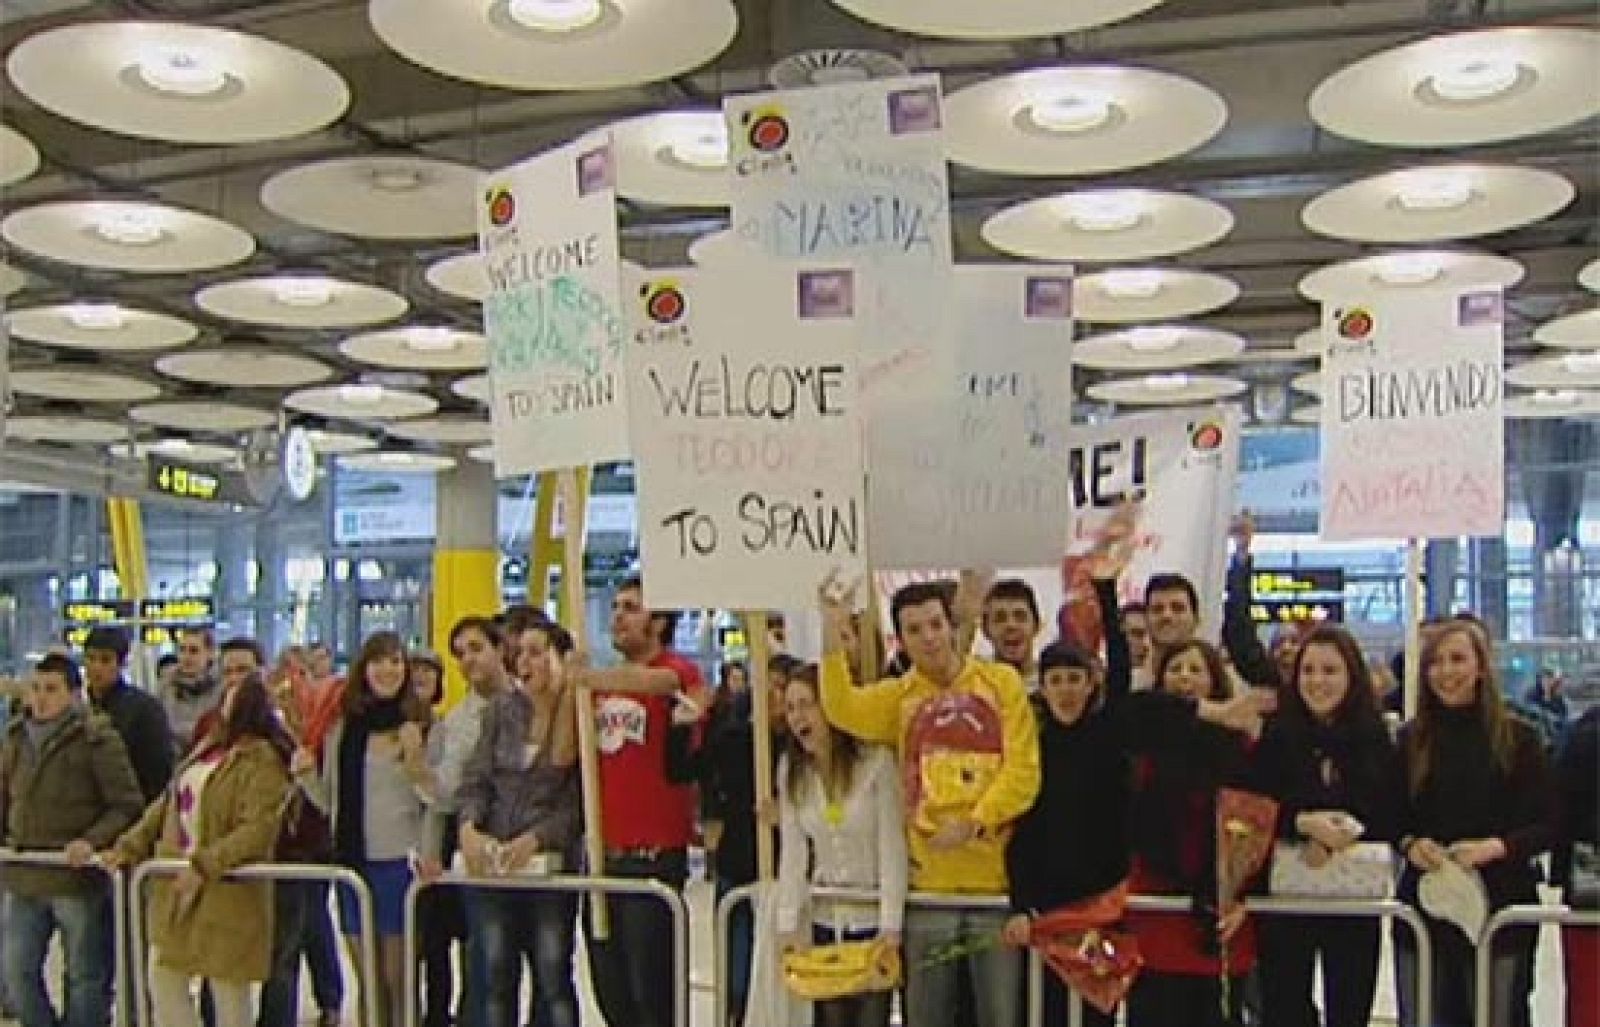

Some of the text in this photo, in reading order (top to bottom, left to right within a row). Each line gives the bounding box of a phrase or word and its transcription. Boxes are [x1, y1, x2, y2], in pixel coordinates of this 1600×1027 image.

[488, 234, 600, 291] WELCOME
[508, 388, 533, 419] TO
[648, 355, 845, 419] WELCOME
[660, 508, 718, 556] TO
